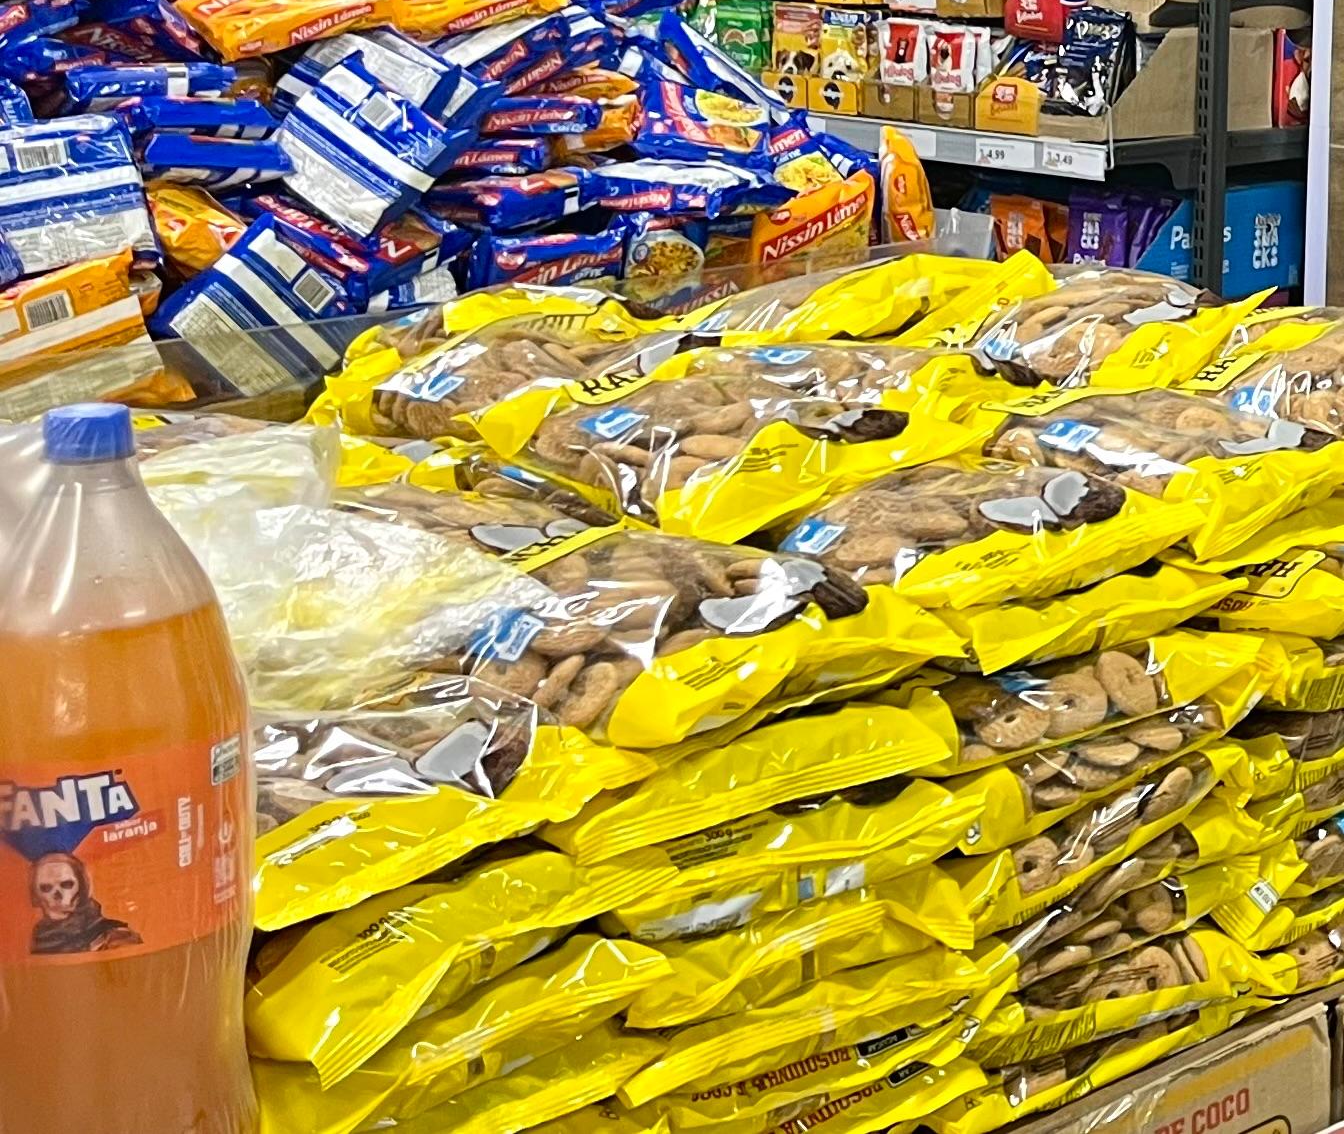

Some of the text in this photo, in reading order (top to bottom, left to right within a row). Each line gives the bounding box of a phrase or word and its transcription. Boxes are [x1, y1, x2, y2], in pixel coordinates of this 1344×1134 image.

[763, 218, 825, 263] Nissin
[103, 820, 158, 843] laranja
[1191, 1087, 1251, 1134] COCO
